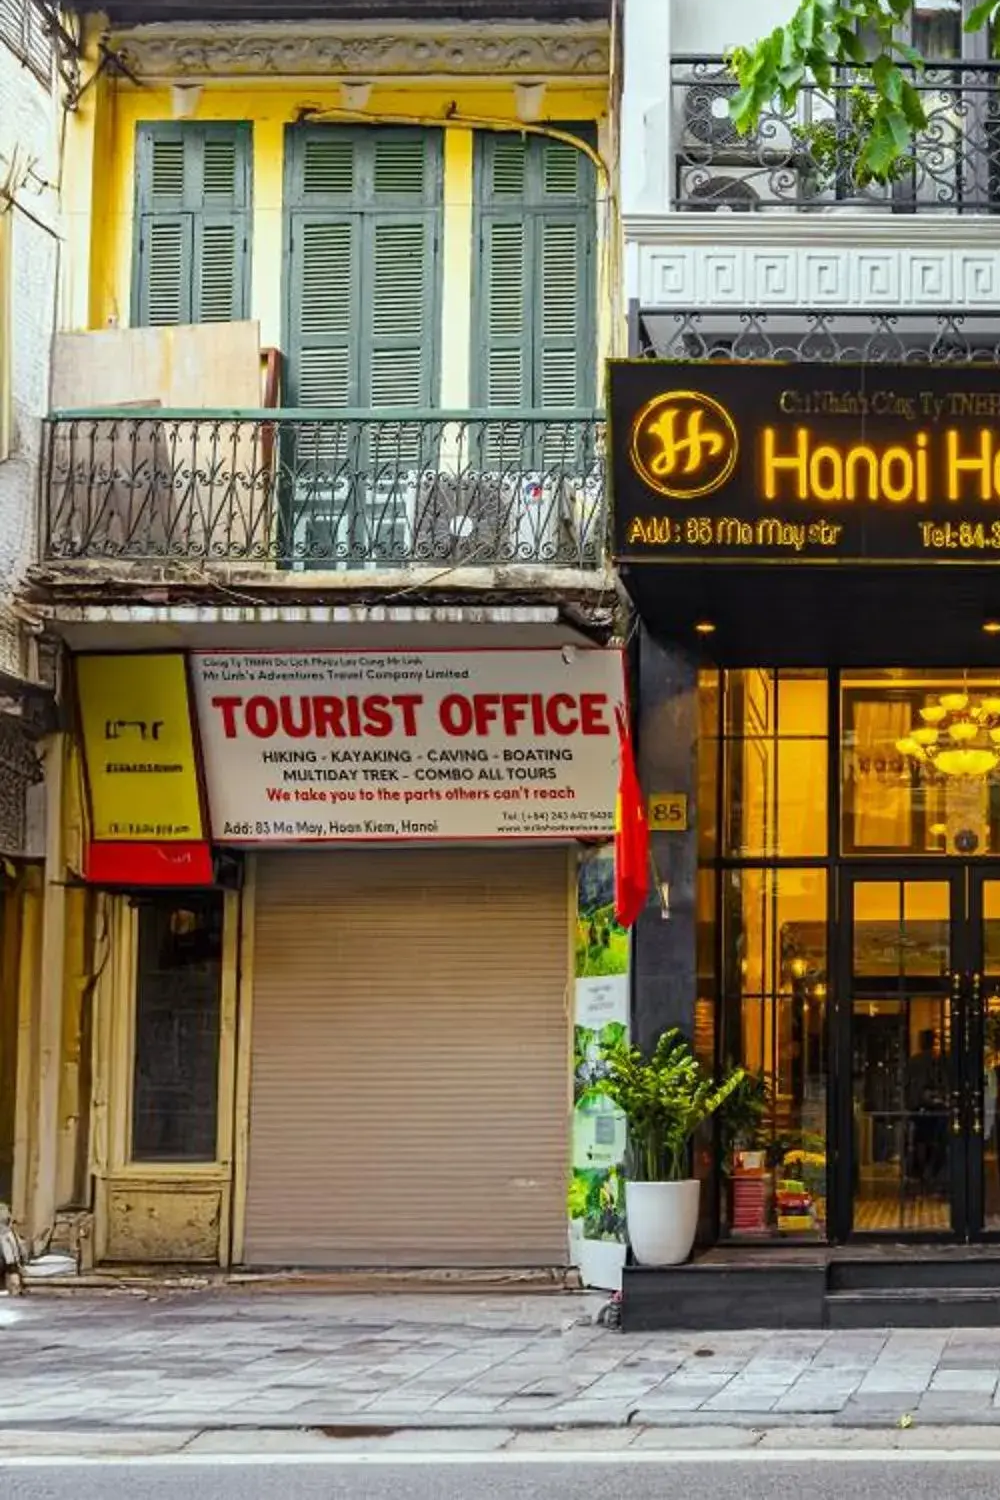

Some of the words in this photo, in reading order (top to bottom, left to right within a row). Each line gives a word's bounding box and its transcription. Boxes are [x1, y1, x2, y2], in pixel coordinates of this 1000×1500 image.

[919, 391, 945, 422] Ty
[762, 426, 928, 503] Hanoi
[685, 516, 713, 545] 85
[715, 516, 752, 545] Ma
[756, 517, 806, 551] May
[202, 671, 219, 681] Mr
[222, 670, 255, 681] Linh's
[258, 670, 324, 681] Adventures
[326, 669, 362, 681] Travel
[365, 668, 423, 683] Company
[425, 668, 470, 680] Limited
[211, 692, 424, 739] TOURIST
[438, 692, 611, 737] OFFICE
[262, 750, 318, 764] HIKING
[331, 750, 413, 764] KAYAKING
[427, 749, 489, 763] CAVING
[503, 748, 574, 762] BOATING
[282, 768, 358, 782] MULTIDAY
[361, 768, 400, 782] TREK
[414, 766, 475, 782] COMBO
[477, 767, 505, 781] ALL
[506, 766, 558, 781] TOURS
[266, 787, 291, 802] We
[294, 787, 327, 802] take
[330, 789, 357, 805] you
[359, 788, 375, 802] to
[377, 786, 401, 801] the
[404, 787, 442, 805] parts
[445, 785, 490, 801] others
[493, 784, 530, 801] can't
[533, 784, 576, 799] reach
[654, 803, 682, 821] 85
[273, 821, 293, 835] Ma
[401, 818, 439, 834] Hanoi
